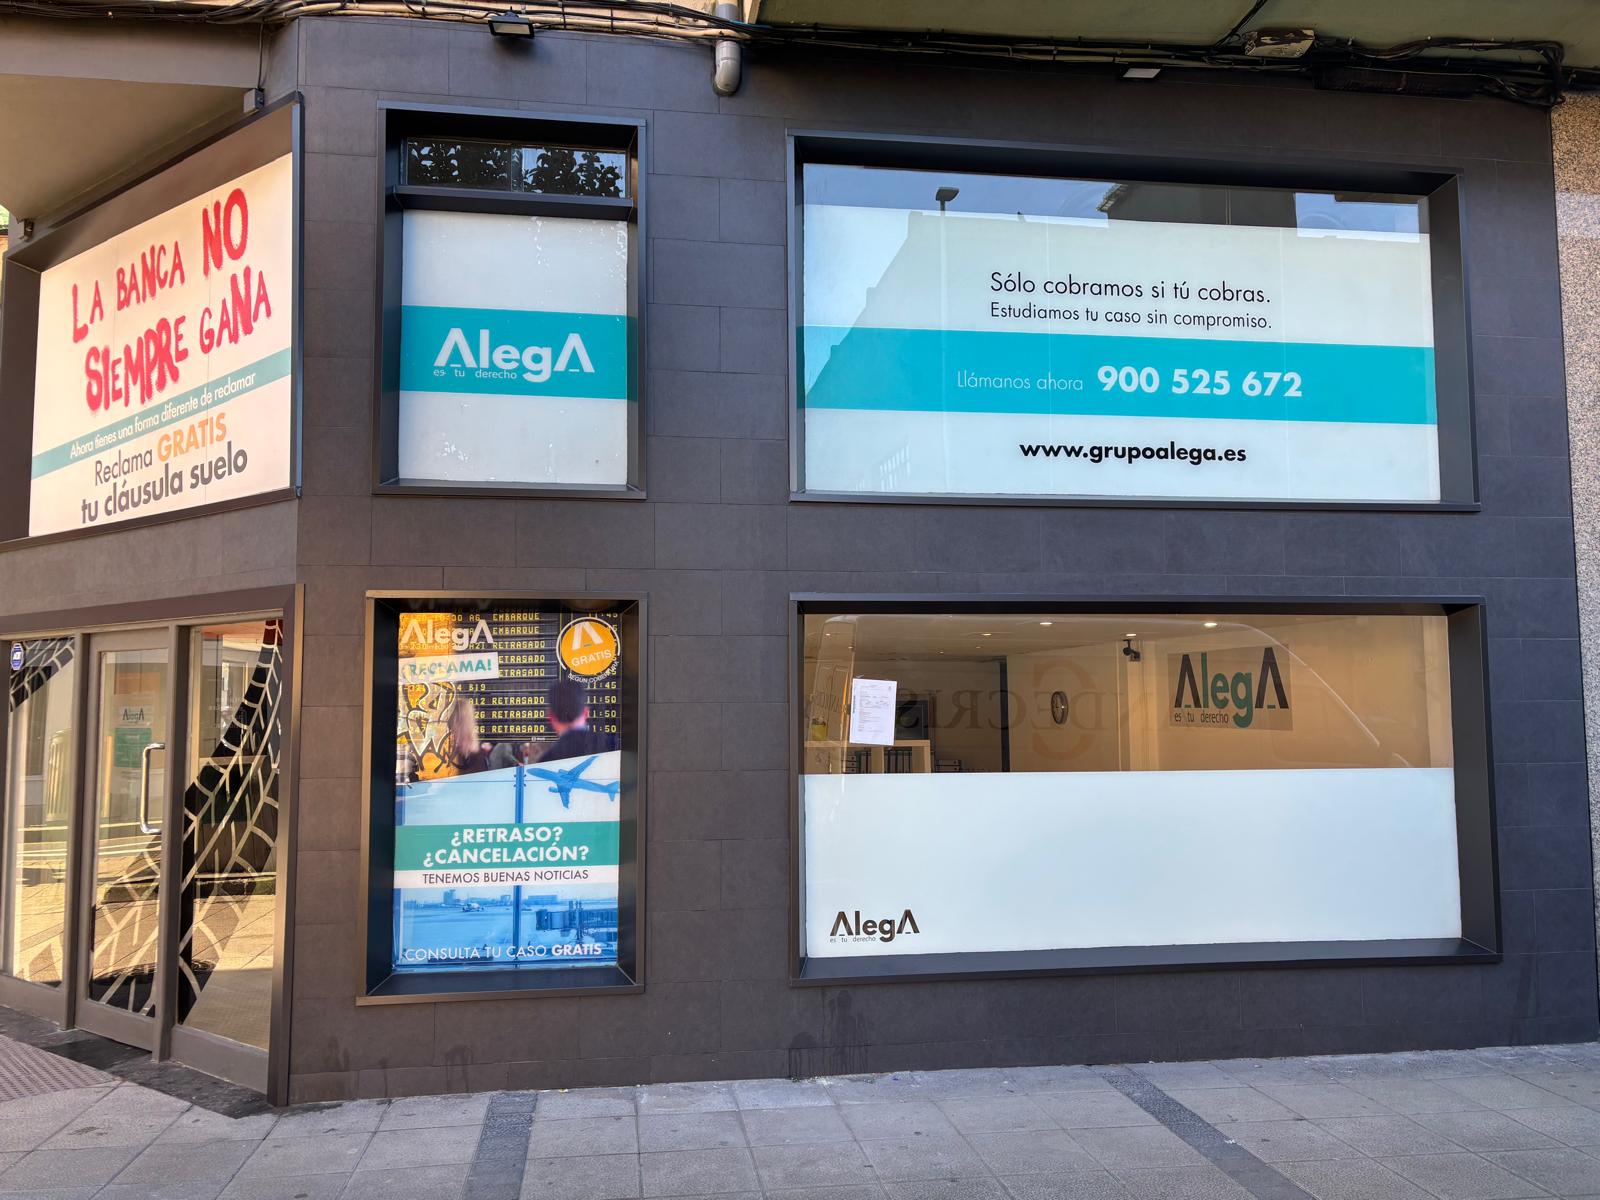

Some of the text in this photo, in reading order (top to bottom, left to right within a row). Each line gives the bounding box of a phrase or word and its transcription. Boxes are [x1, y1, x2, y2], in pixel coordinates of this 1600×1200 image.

[72, 188, 249, 343] LA BANCA NO
[990, 272, 1271, 303] Sólo cobramos si tú cobras.
[991, 302, 1272, 330] Estudiamos tu caso sin compromiso.
[84, 264, 272, 412] SIEMPRE GANA
[433, 327, 595, 383] AlegA
[433, 368, 517, 380] es tu derecho
[957, 365, 1303, 397] Llámanos ahora 900 525 672
[70, 372, 256, 459] Ahora tienes una forma diferente de reclamar
[95, 412, 227, 486] Reclama GRATIS
[1019, 441, 1247, 465] www.grupoalega.es
[81, 440, 248, 524] tu cláusula suelo
[492, 612, 540, 621] EMBARQUE
[492, 641, 546, 650] RETRASADO
[499, 655, 545, 664] ETRASADO
[571, 649, 612, 666] GRATIS
[499, 668, 545, 677] ETRASADO
[1174, 647, 1289, 728] AlegA
[491, 696, 545, 705] RETRASADO
[587, 695, 617, 704] 11:50
[491, 710, 545, 719] RETRASADO
[1175, 710, 1229, 724] es tu derecho
[491, 725, 545, 733] RETRASADO
[451, 826, 563, 847] ¿RETRASO?
[423, 843, 589, 868] ¿CANCELACIÓN?
[422, 869, 589, 885] TENEMOS BUENAS NOTICIAS
[829, 909, 920, 943] AlegA
[405, 943, 602, 962] CONSULTA TU CASO GRATIS
